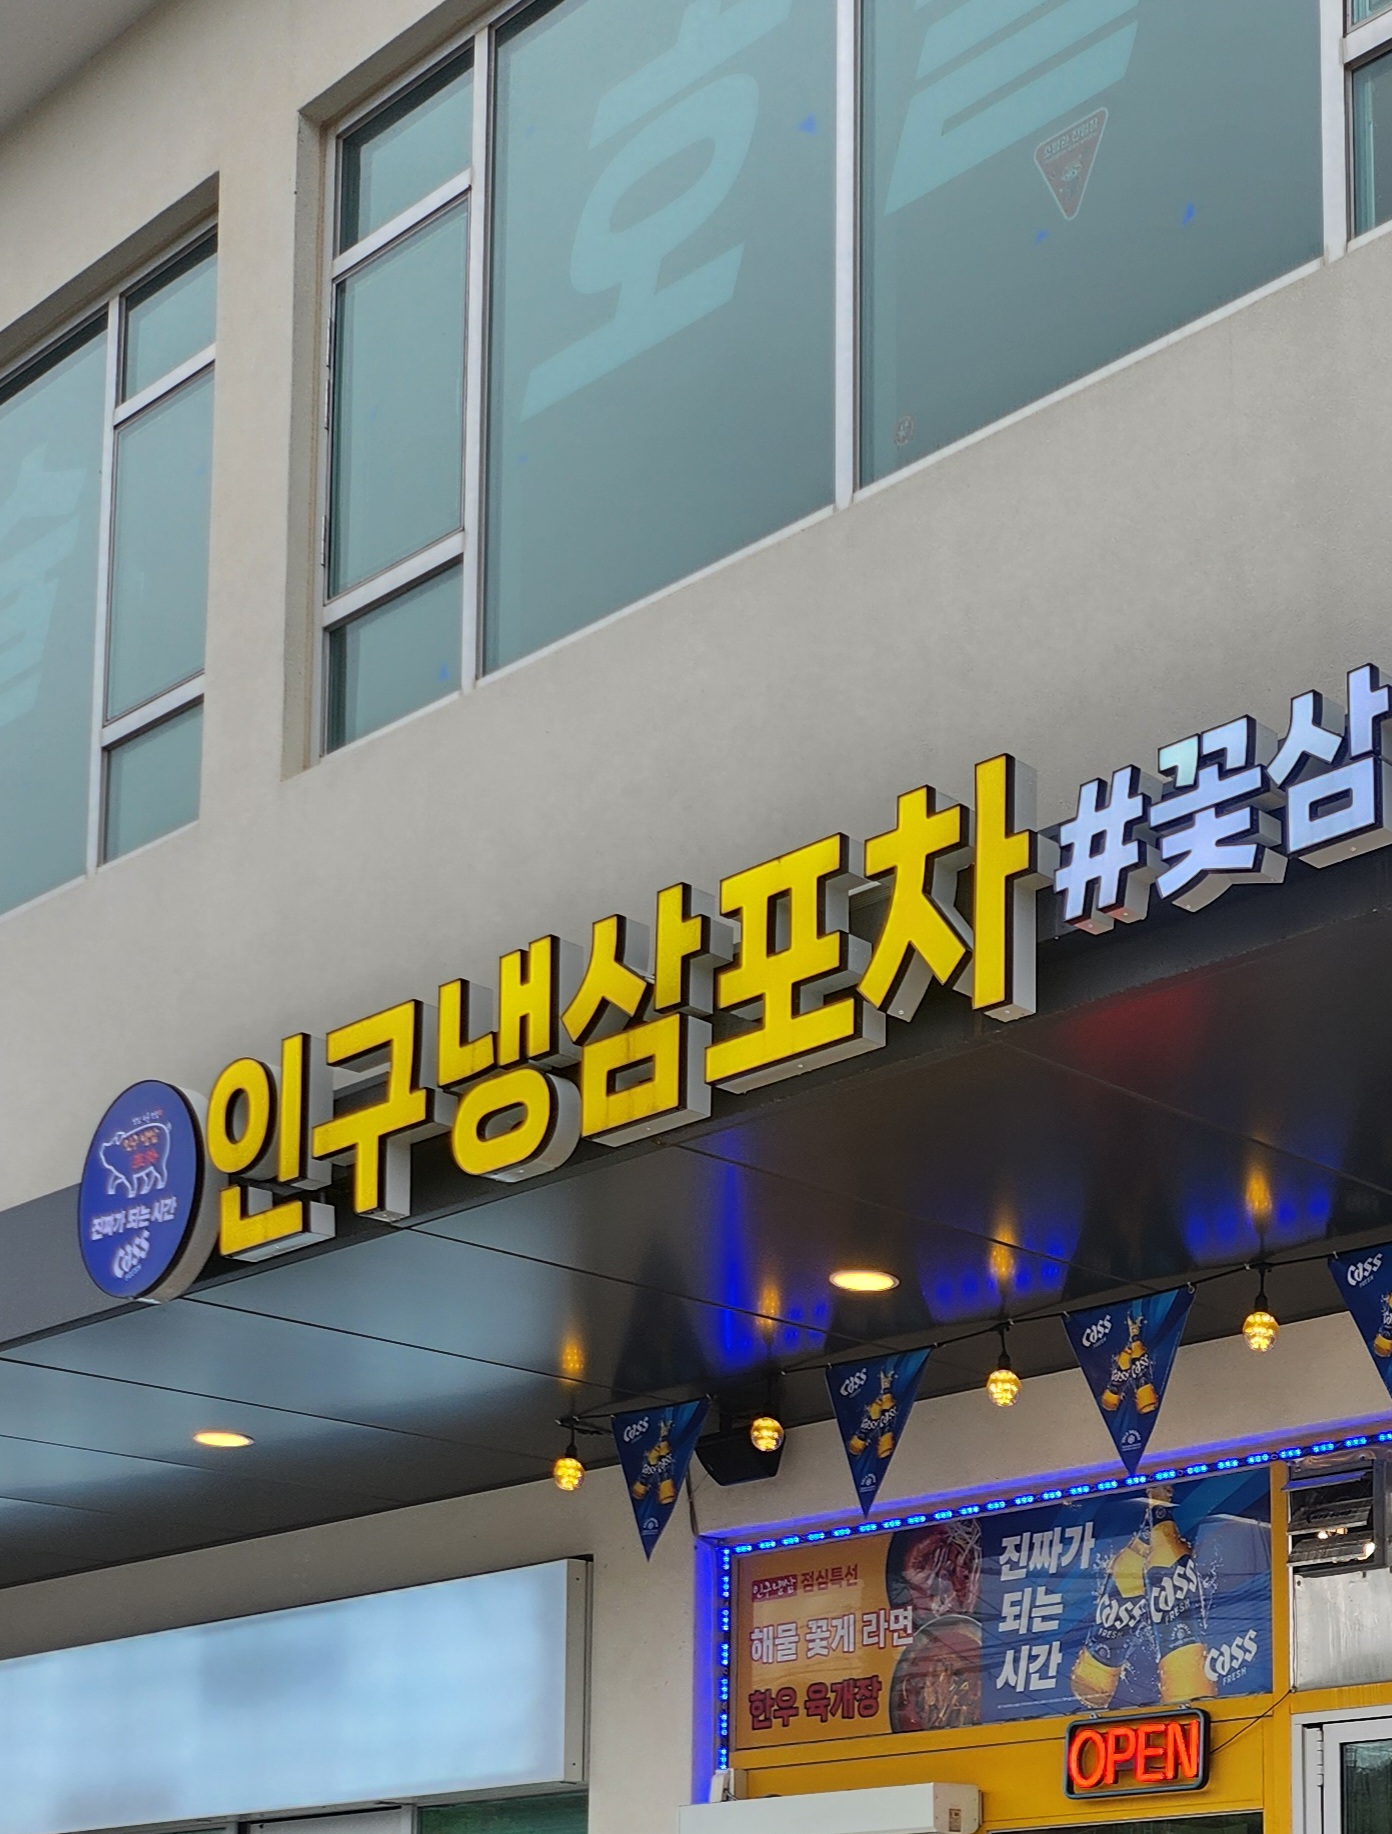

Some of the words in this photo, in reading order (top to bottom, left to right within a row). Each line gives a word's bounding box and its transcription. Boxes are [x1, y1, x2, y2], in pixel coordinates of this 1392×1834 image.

[206, 752, 1032, 1260] 인구냉삼포차
[999, 1521, 1096, 1582] 진짜가
[752, 1577, 797, 1599] 인구냉삼
[801, 1564, 859, 1593] 점심특선
[750, 1621, 799, 1664] 해물
[805, 1614, 856, 1659] 꽃게
[862, 1605, 915, 1648] 라면
[998, 1586, 1064, 1635] 되는
[996, 1641, 1063, 1692] 시간
[1222, 1668, 1247, 1687] FRESH
[749, 1687, 799, 1731] 한우
[805, 1675, 882, 1723] 육개장
[1068, 1719, 1200, 1789] OPEN
